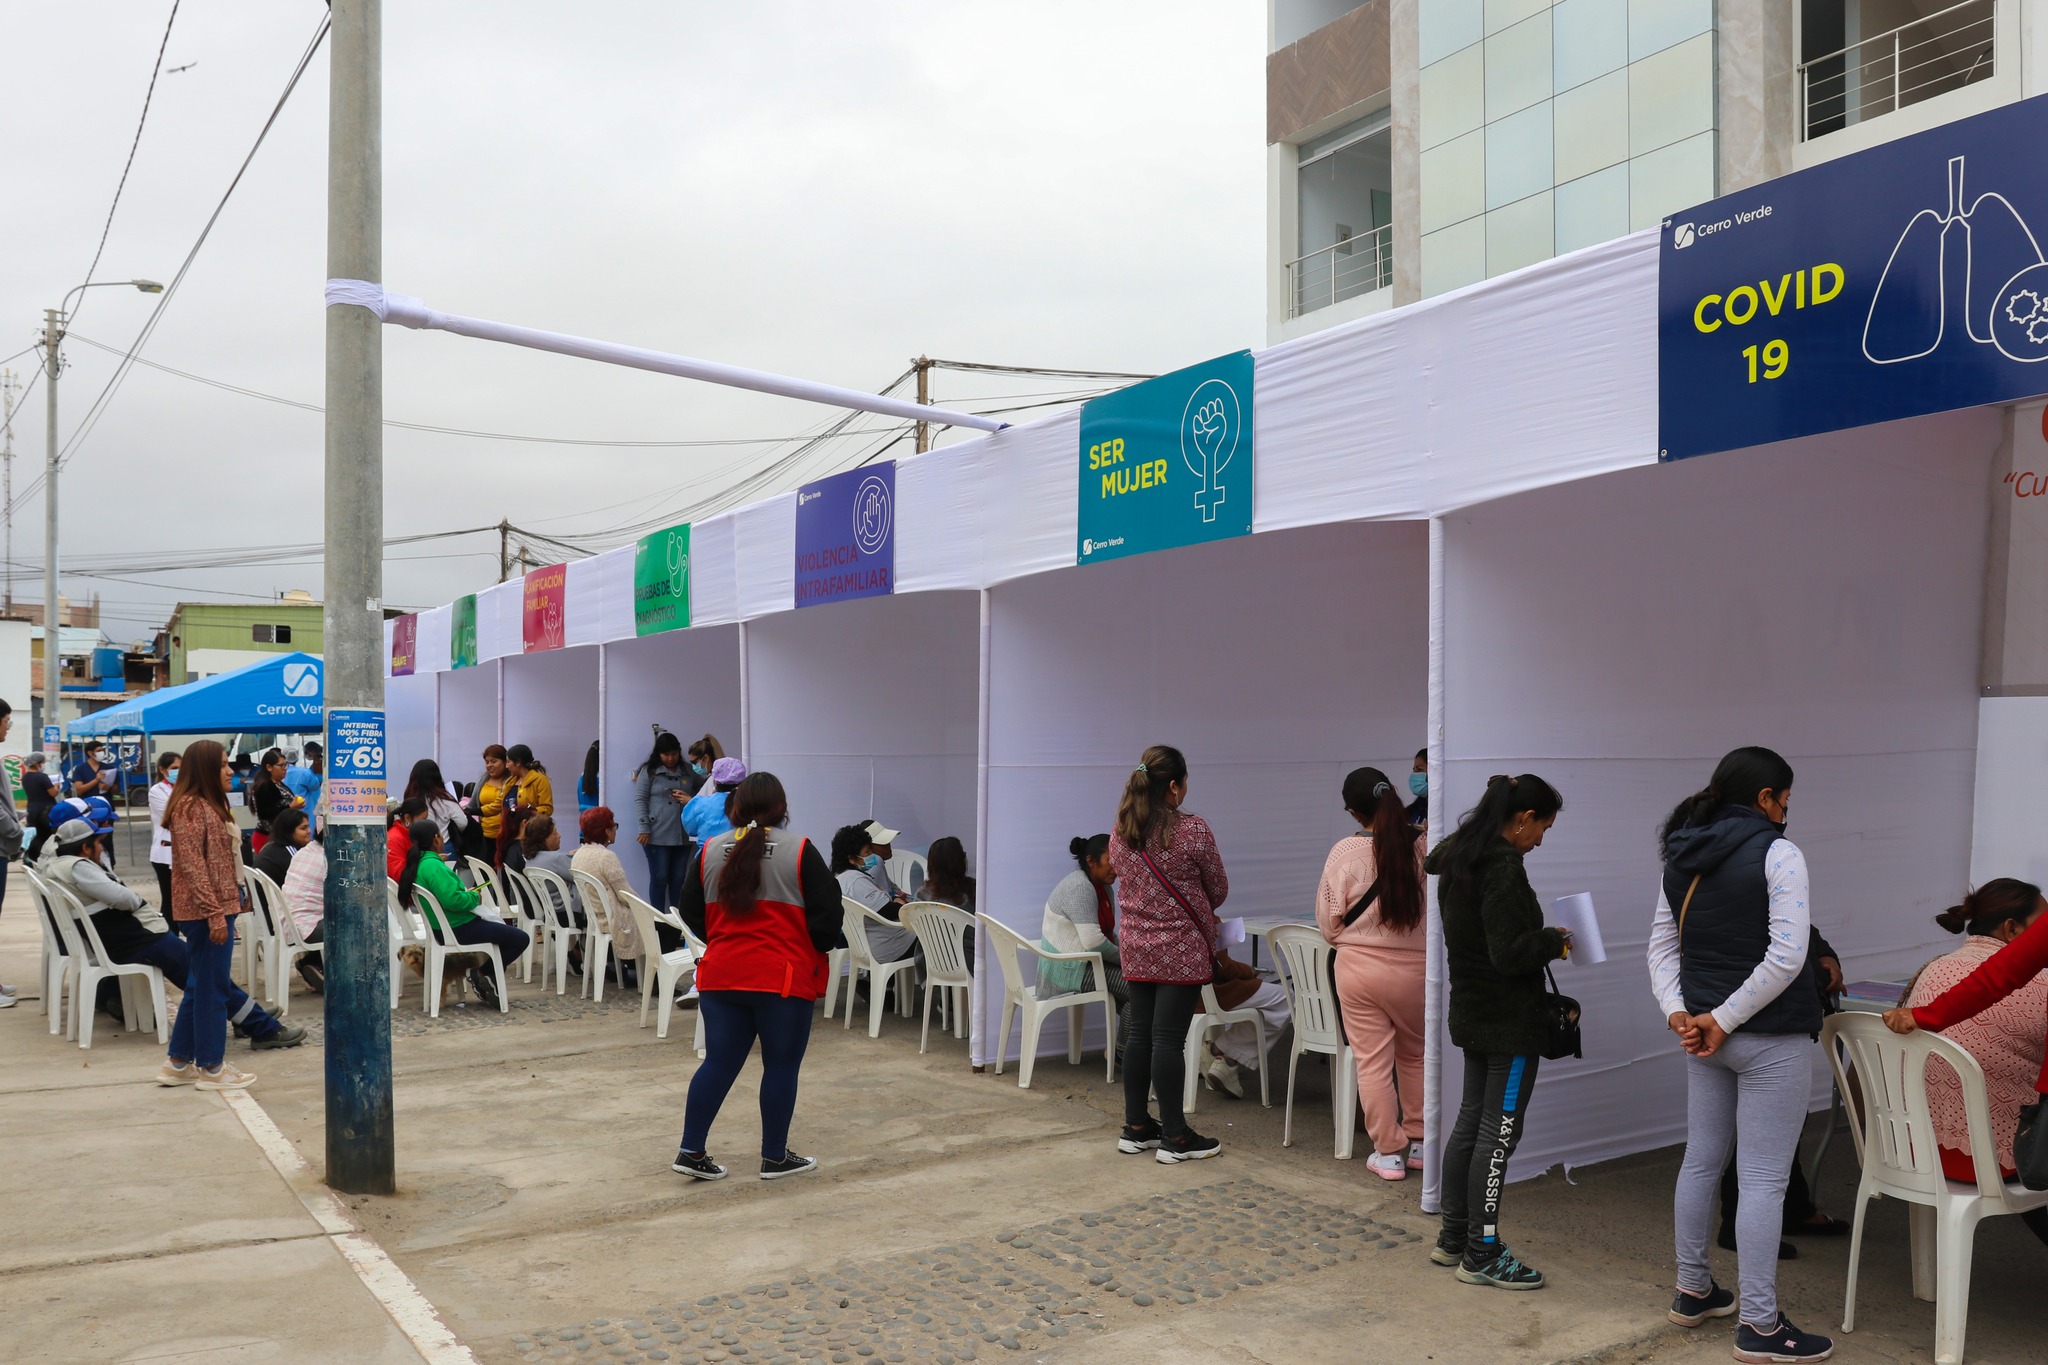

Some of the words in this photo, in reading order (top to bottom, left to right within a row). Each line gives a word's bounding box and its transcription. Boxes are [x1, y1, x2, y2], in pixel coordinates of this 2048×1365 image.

[1698, 219, 1732, 237] Cerro
[1735, 205, 1773, 225] Verde
[1693, 262, 1845, 334] COVID
[1742, 339, 1790, 384] 19
[1089, 437, 1125, 470] SER
[1101, 458, 1168, 499] MUJER
[1092, 541, 1108, 550] Cerro
[1108, 536, 1125, 547] Verde
[797, 543, 859, 574] VIOLENCIA
[661, 579, 671, 596] DE
[797, 567, 889, 601] INTRAFAMILIAR
[526, 595, 549, 612] FAMILIAR
[256, 703, 297, 715] Cerro
[336, 729, 359, 737] 100%
[345, 735, 378, 745] ÓPTICA
[335, 754, 351, 768] S/
[352, 745, 384, 769] 69
[338, 787, 357, 795] 053
[336, 805, 355, 813] 949
[357, 805, 374, 813] 271
[1498, 1115, 1515, 1147] X&Y
[1484, 1148, 1505, 1213] CLASSIC
